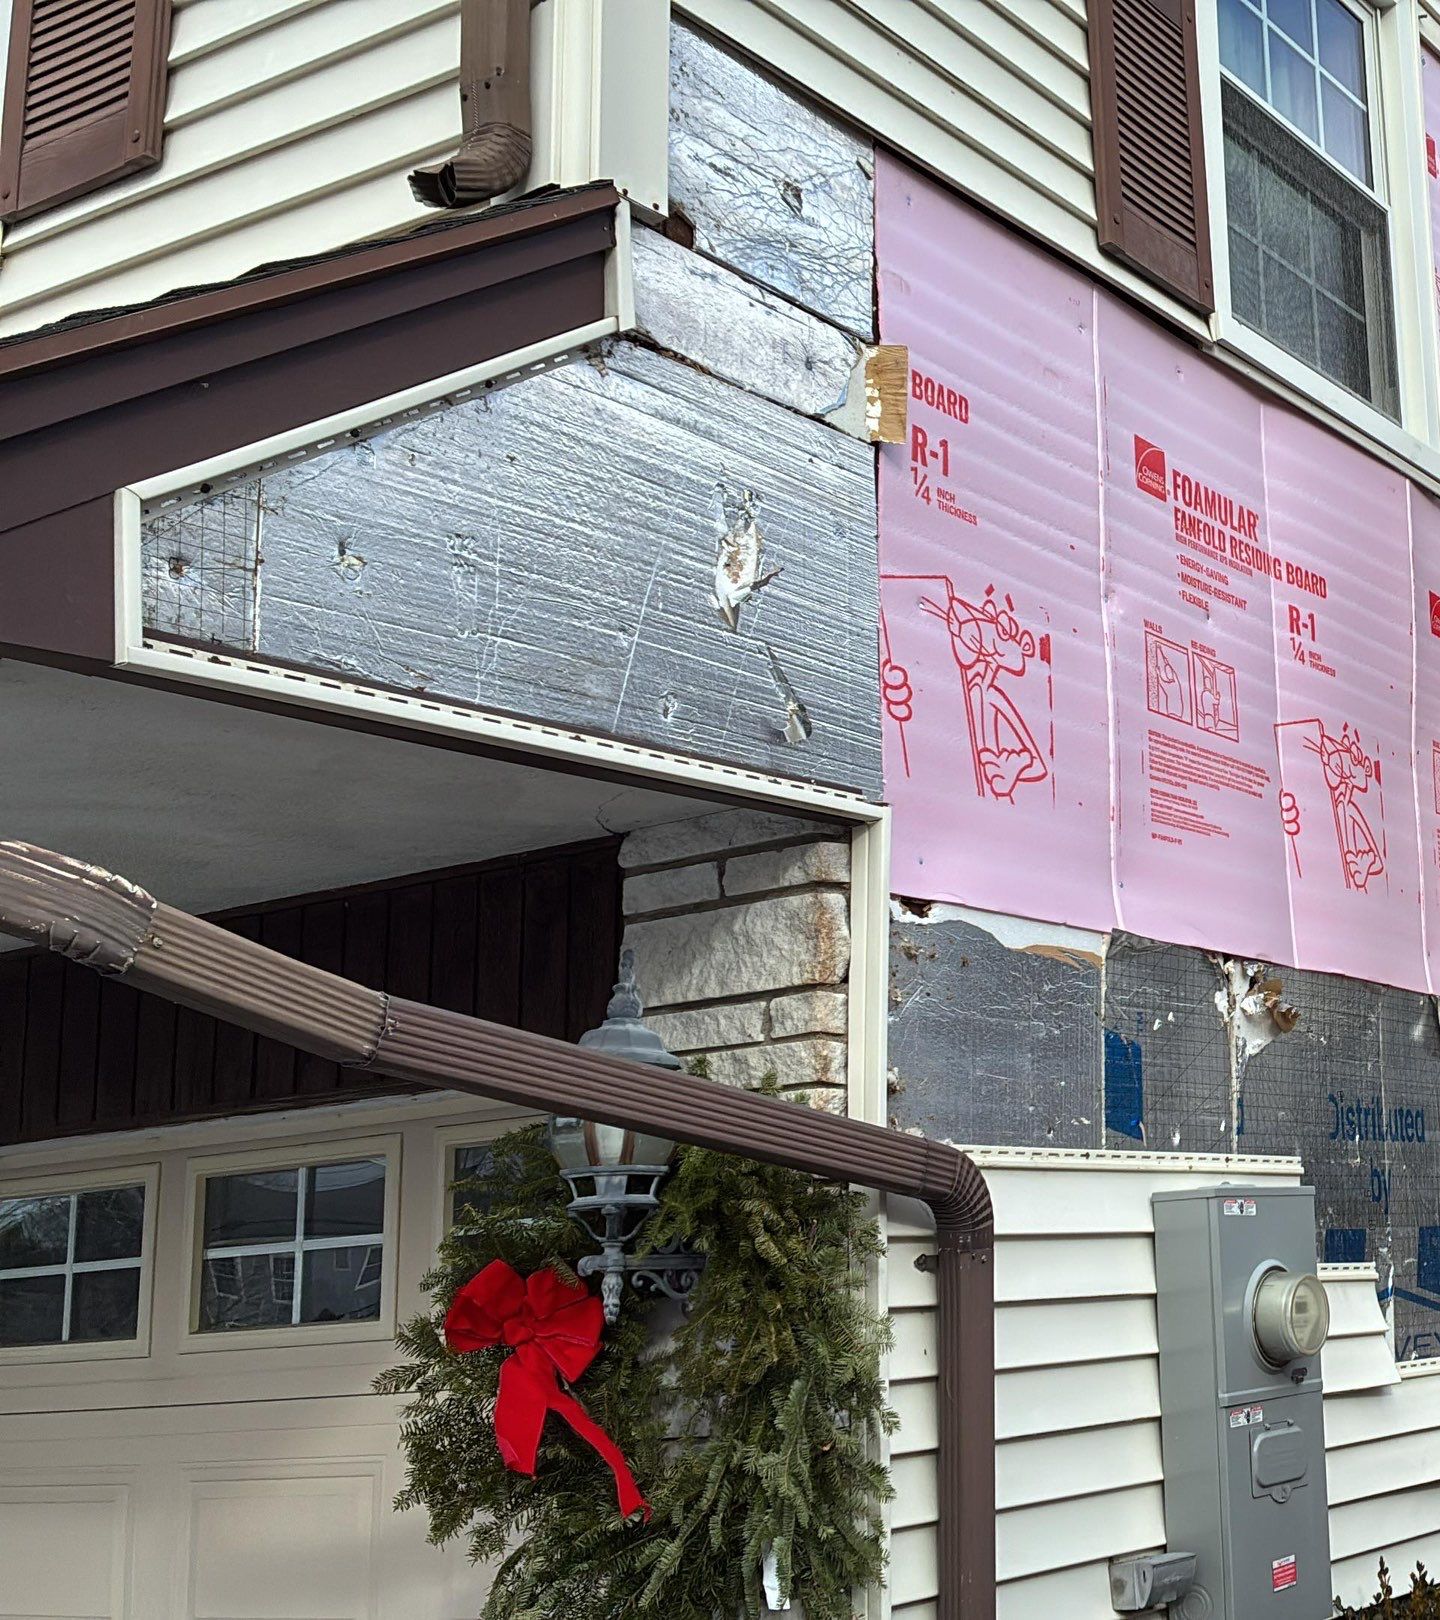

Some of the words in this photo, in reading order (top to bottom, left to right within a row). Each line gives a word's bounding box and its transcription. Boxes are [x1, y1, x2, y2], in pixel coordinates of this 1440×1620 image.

[911, 369, 969, 424] BOARD
[911, 424, 949, 477] R-1
[937, 487, 955, 504] INCH
[937, 499, 977, 526] THICKNESS
[1172, 468, 1258, 542] FOAMULAR
[1174, 506, 1226, 553] FANFOLD
[1230, 534, 1283, 582] RESIDING
[1285, 561, 1328, 599] BOARD
[1182, 591, 1209, 612] FLEXIBLE
[1143, 618, 1162, 634] WALLS
[1288, 604, 1316, 642] R-1
